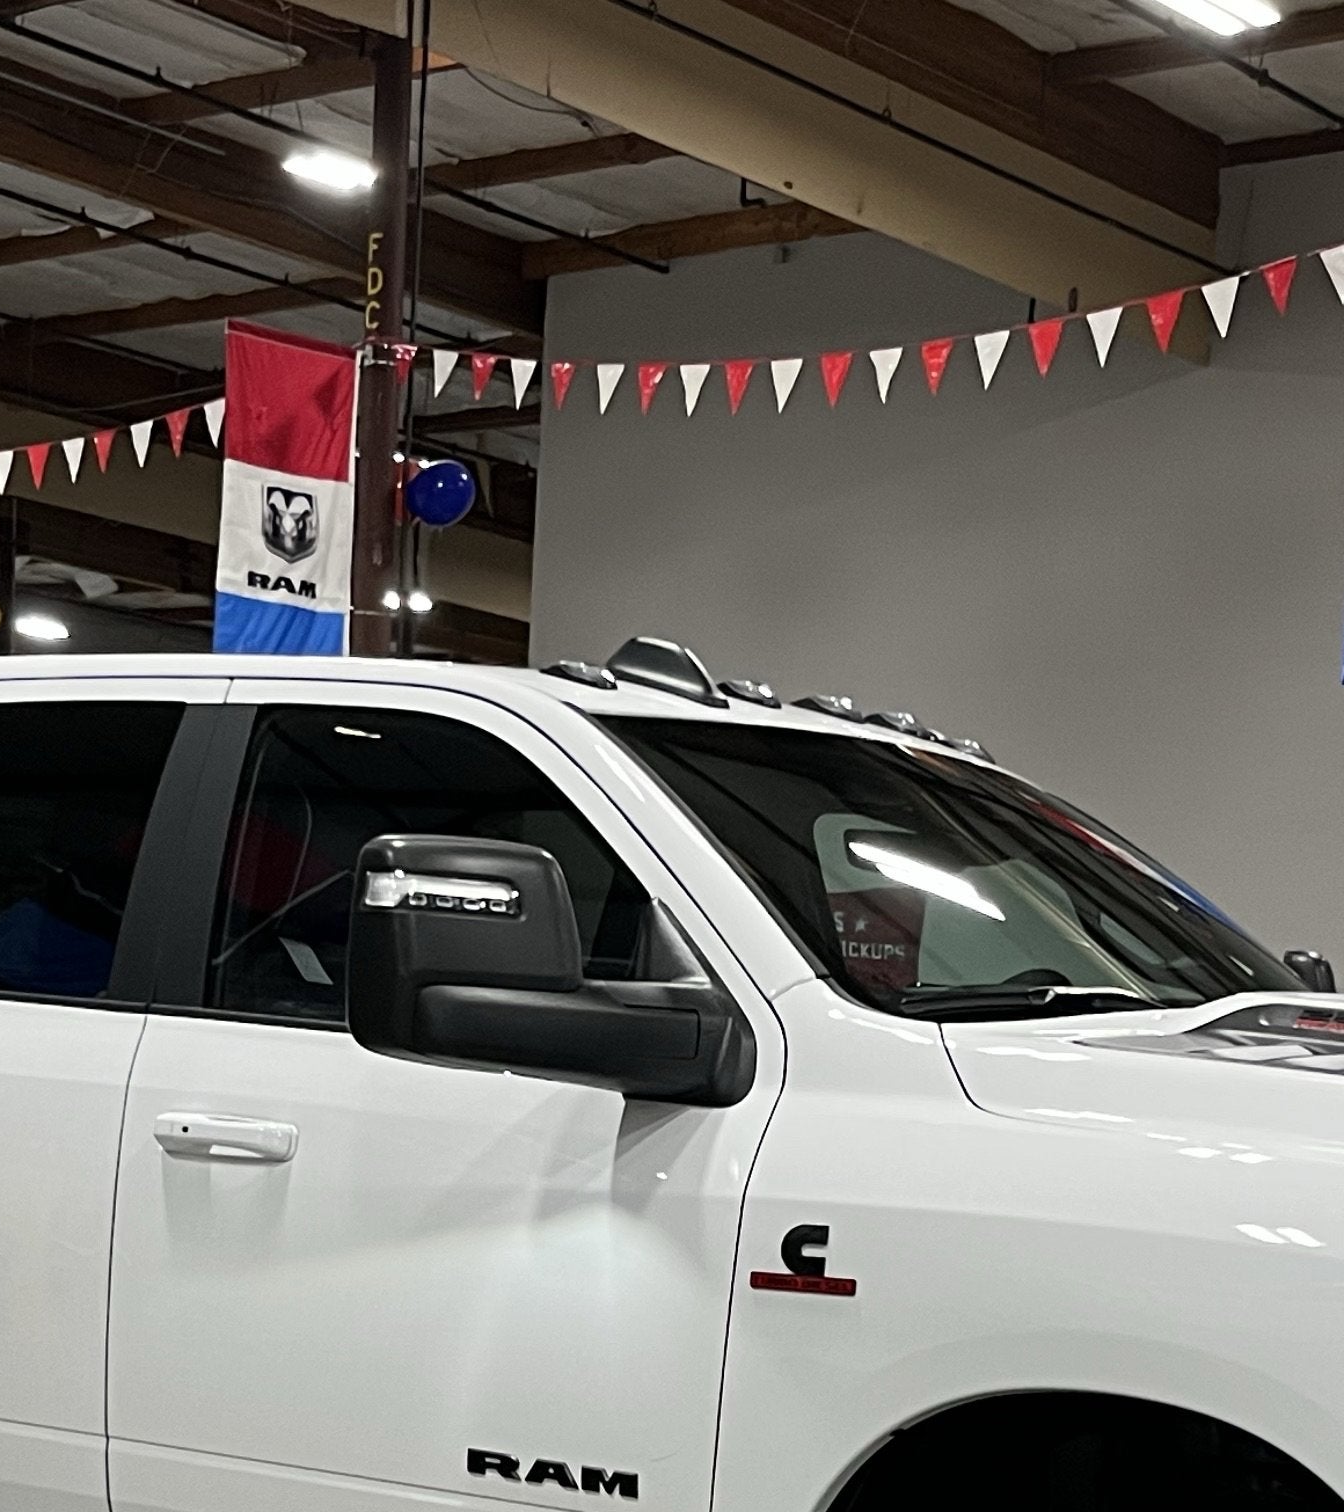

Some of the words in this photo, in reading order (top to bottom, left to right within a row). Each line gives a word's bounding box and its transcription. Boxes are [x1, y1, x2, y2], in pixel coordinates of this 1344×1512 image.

[247, 570, 317, 599] RAM
[840, 940, 905, 960] ICKUPS
[466, 1447, 639, 1500] RAM
